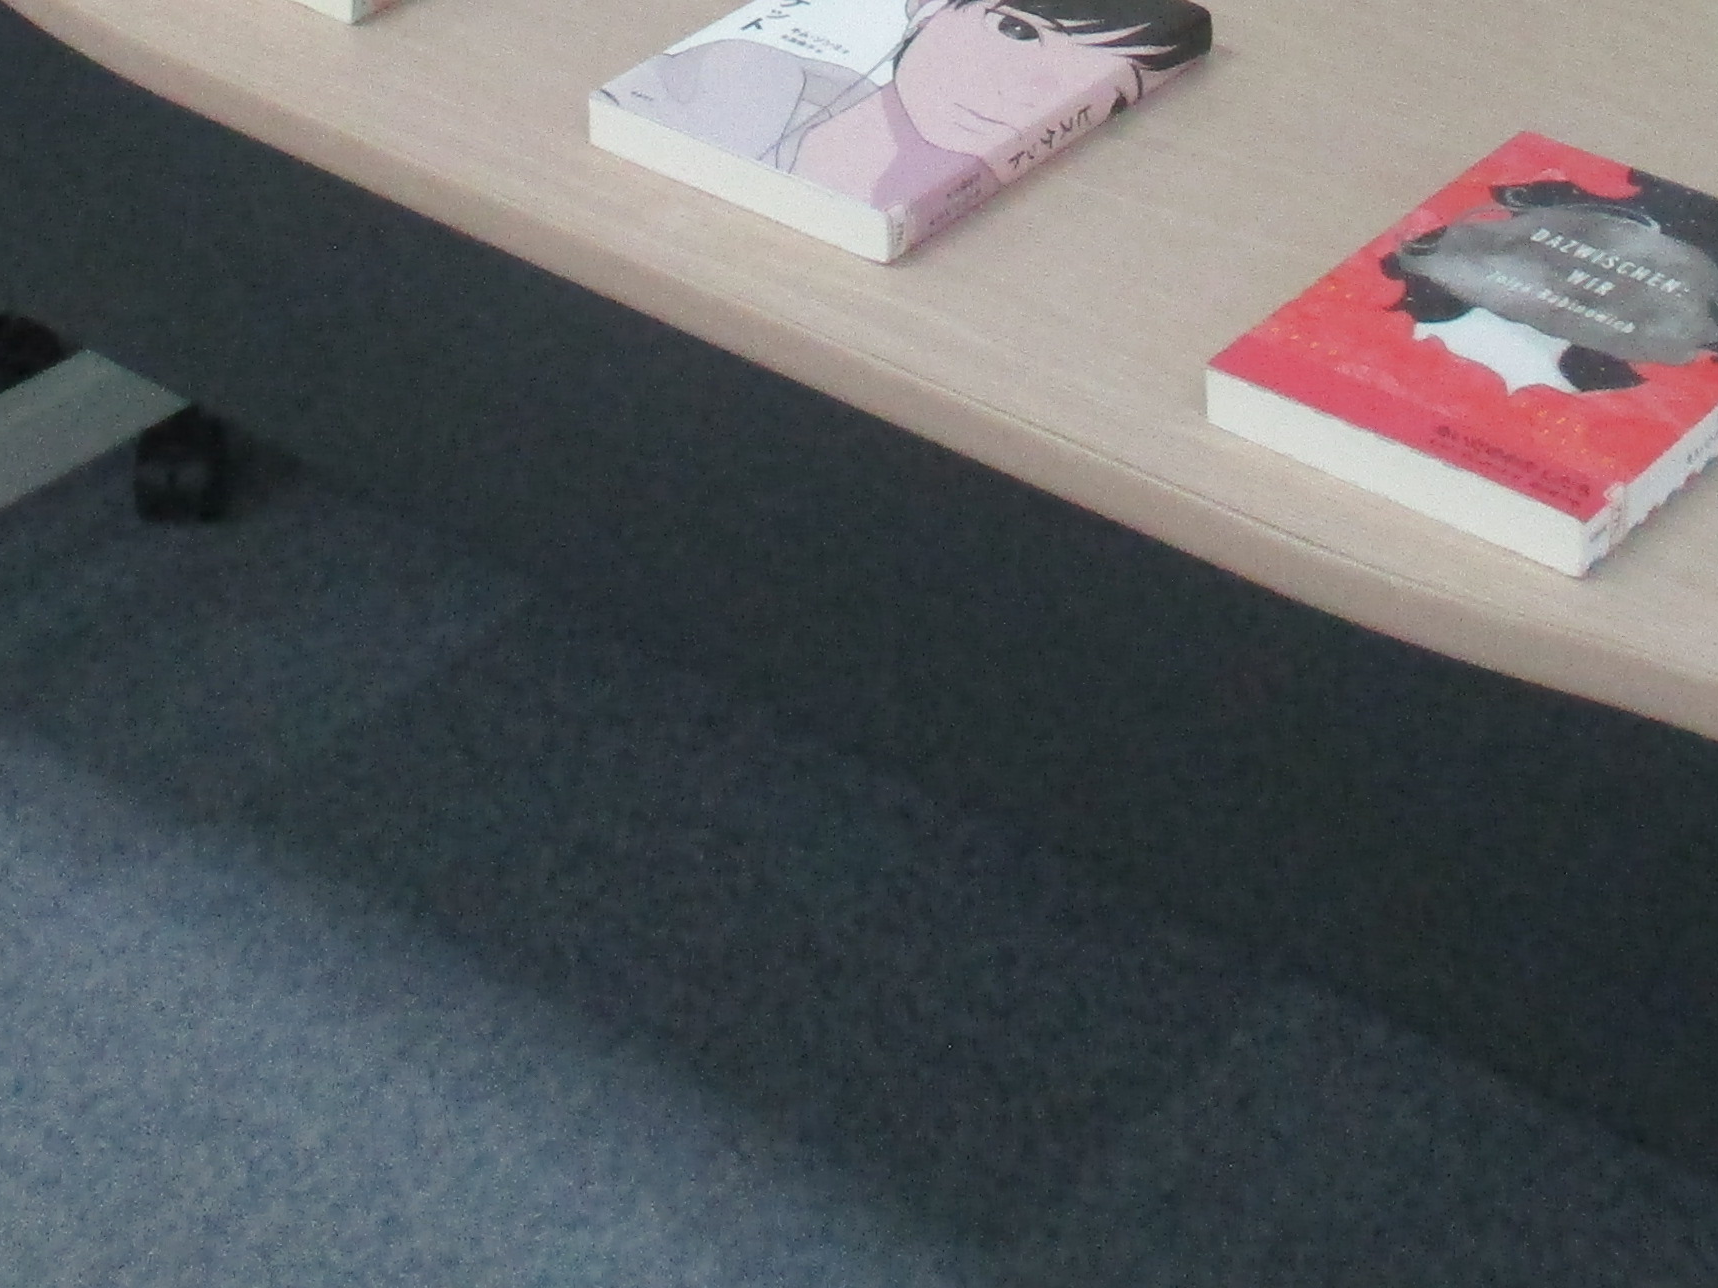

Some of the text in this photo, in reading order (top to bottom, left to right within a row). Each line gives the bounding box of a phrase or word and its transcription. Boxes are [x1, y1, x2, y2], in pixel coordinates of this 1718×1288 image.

[1007, 104, 1094, 170] ビスケット
[1565, 268, 1617, 298] WIR
